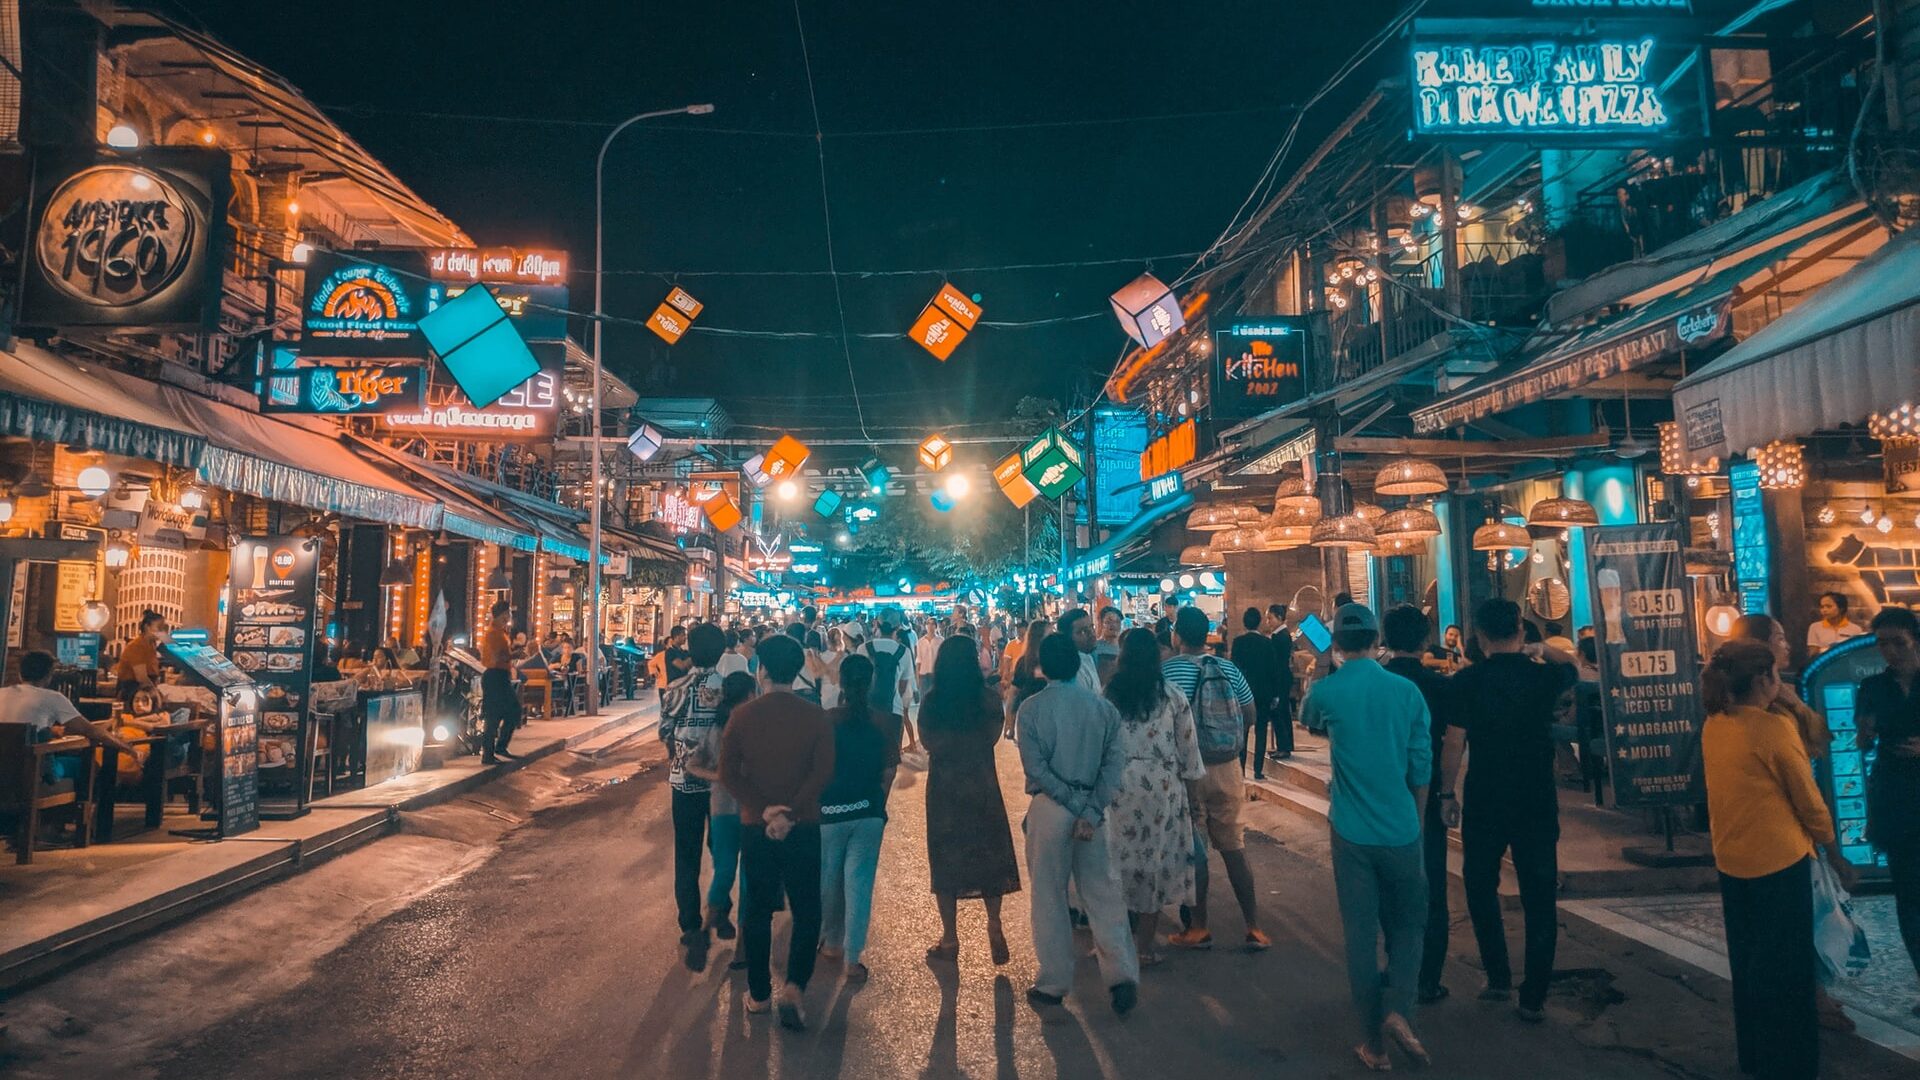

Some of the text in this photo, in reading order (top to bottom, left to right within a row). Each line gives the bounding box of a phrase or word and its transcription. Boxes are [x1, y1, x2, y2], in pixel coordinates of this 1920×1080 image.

[60, 226, 168, 296] 1960
[311, 279, 335, 311] World
[943, 293, 975, 320] TEMPLE
[307, 320, 417, 330] Wood Fired Pizza
[924, 318, 951, 346] TEMPLE
[1676, 305, 1718, 343] Carlsberg
[336, 366, 407, 405] Tiger
[1039, 461, 1069, 487] TEMPLE
[1631, 592, 1676, 615] $0.50
[1634, 620, 1661, 629] DRAFT
[1627, 654, 1668, 674] $1.75
[1623, 681, 1694, 699] LONG ISLAND
[1625, 698, 1673, 714] ICED TEA
[1628, 719, 1692, 737] MARGARITA
[1631, 744, 1672, 759] MOJITO
